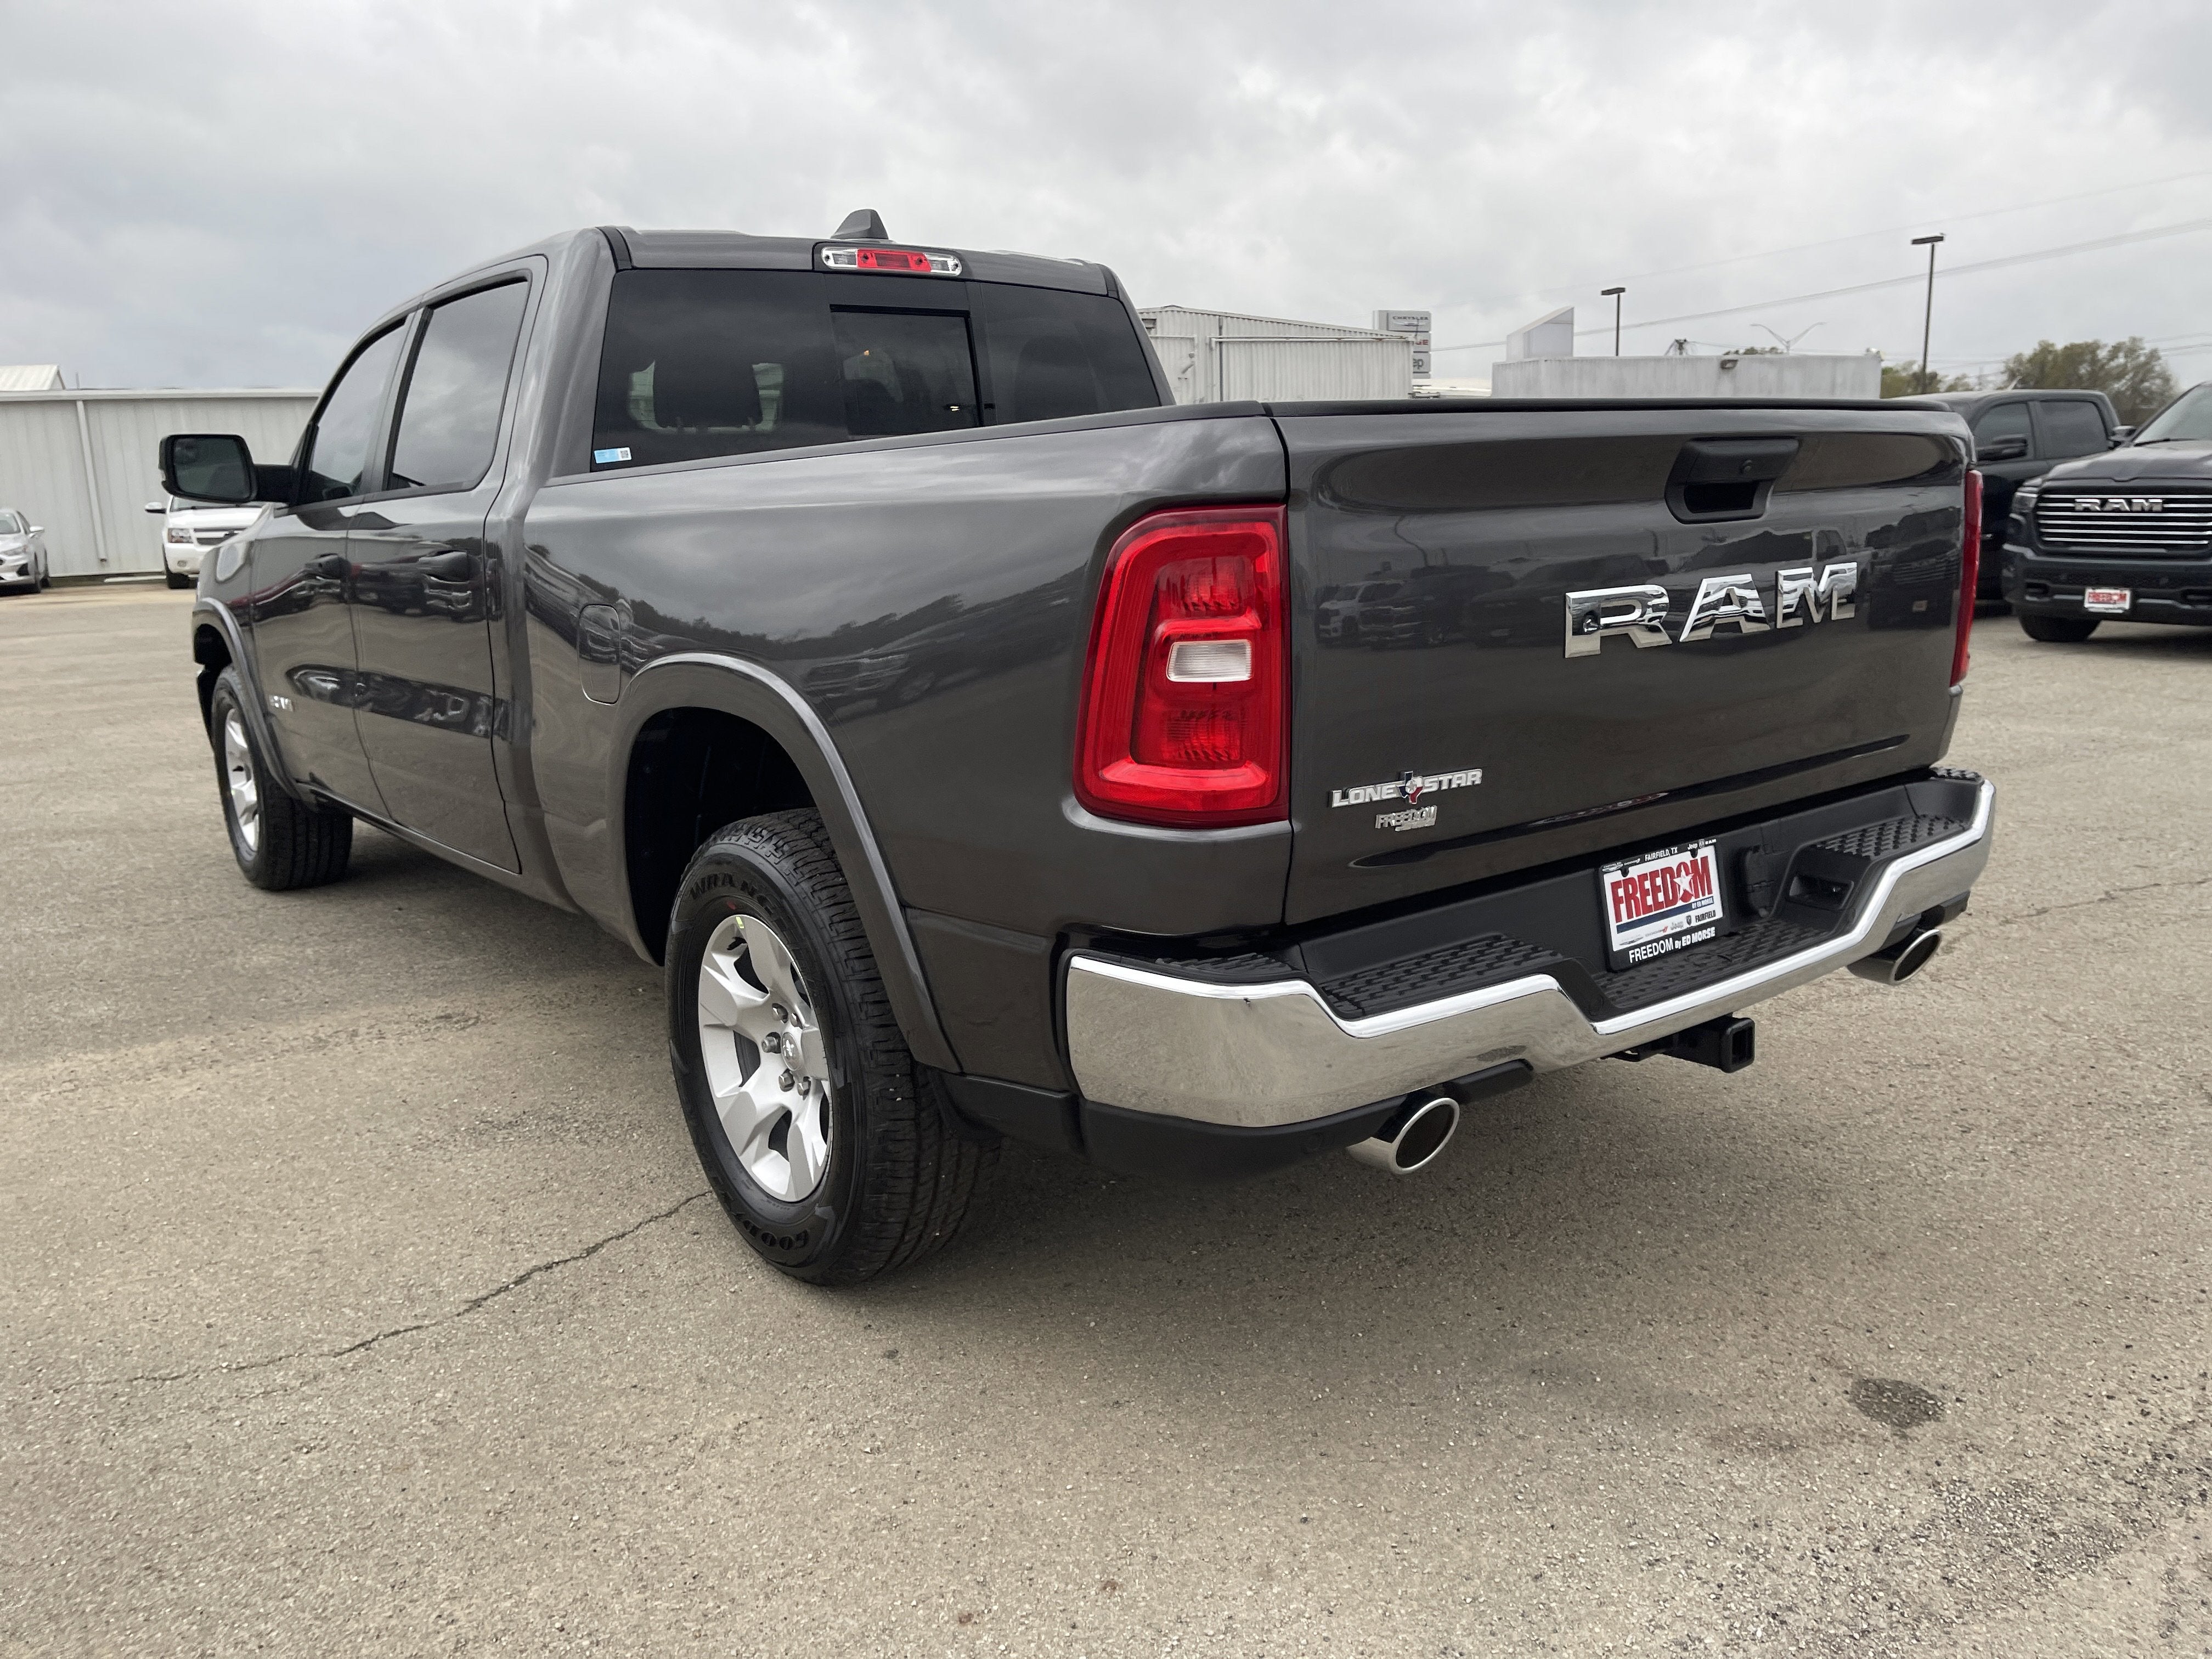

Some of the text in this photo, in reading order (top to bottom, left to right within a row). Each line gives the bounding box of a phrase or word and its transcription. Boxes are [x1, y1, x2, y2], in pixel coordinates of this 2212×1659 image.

[2074, 498, 2163, 512] RAM
[1565, 562, 1858, 658] RAM
[1331, 769, 1482, 808] LONE STAR
[1375, 805, 1437, 829] FREEDOM
[1645, 849, 1671, 861] FAIRFIELD,
[1611, 855, 1713, 924] FREEDOM
[1695, 910, 1717, 923] FAIRFIELD
[1628, 938, 1674, 963] FREEDOM
[1681, 935, 1691, 947] ED
[1691, 927, 1716, 944] MORSE
